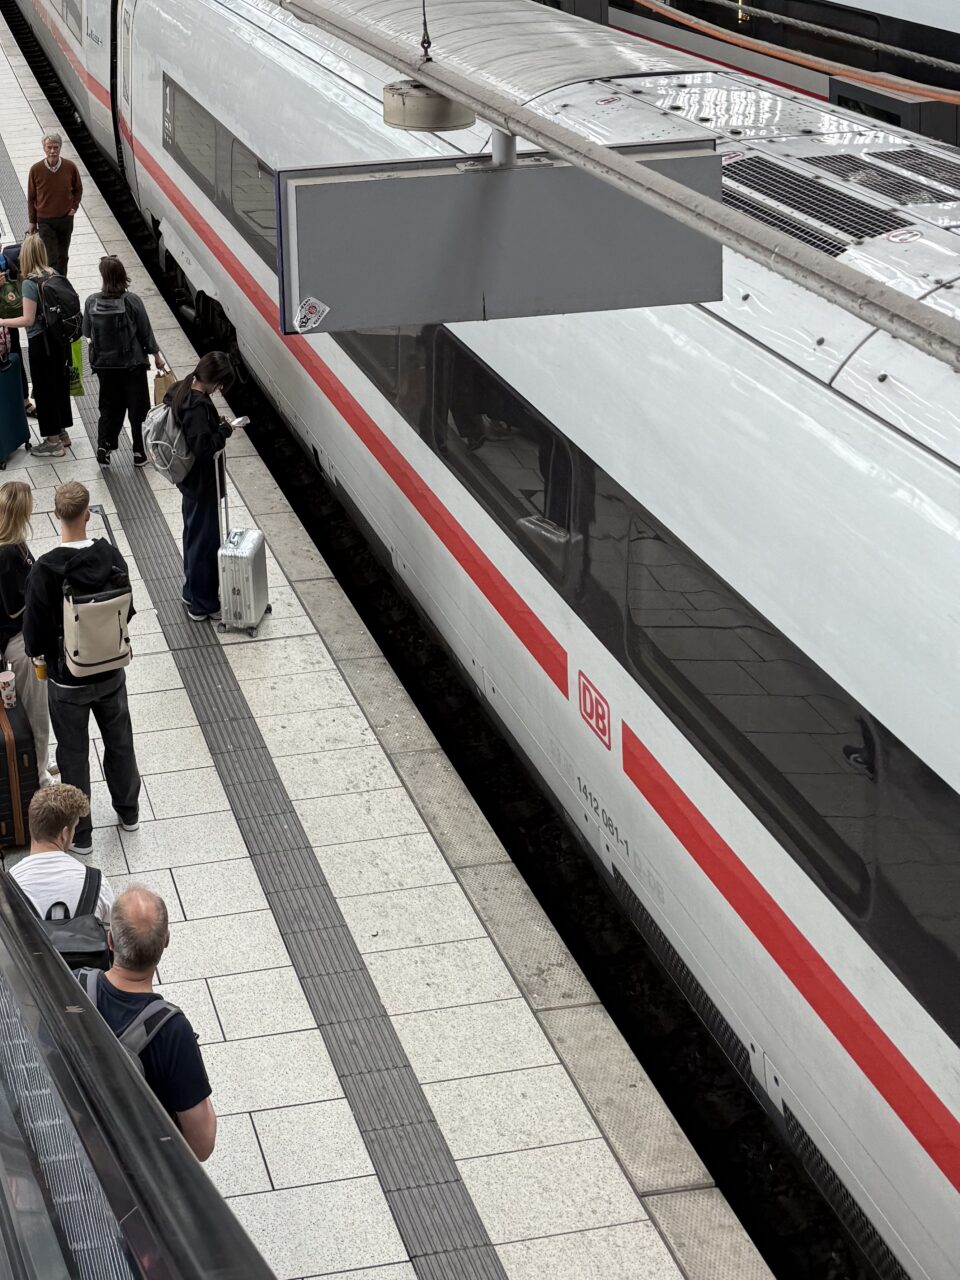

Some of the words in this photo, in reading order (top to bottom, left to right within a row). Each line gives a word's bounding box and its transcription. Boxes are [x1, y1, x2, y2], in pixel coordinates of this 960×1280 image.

[581, 679, 609, 739] DB
[577, 776, 600, 817] 1412
[601, 808, 630, 857] 081-1
